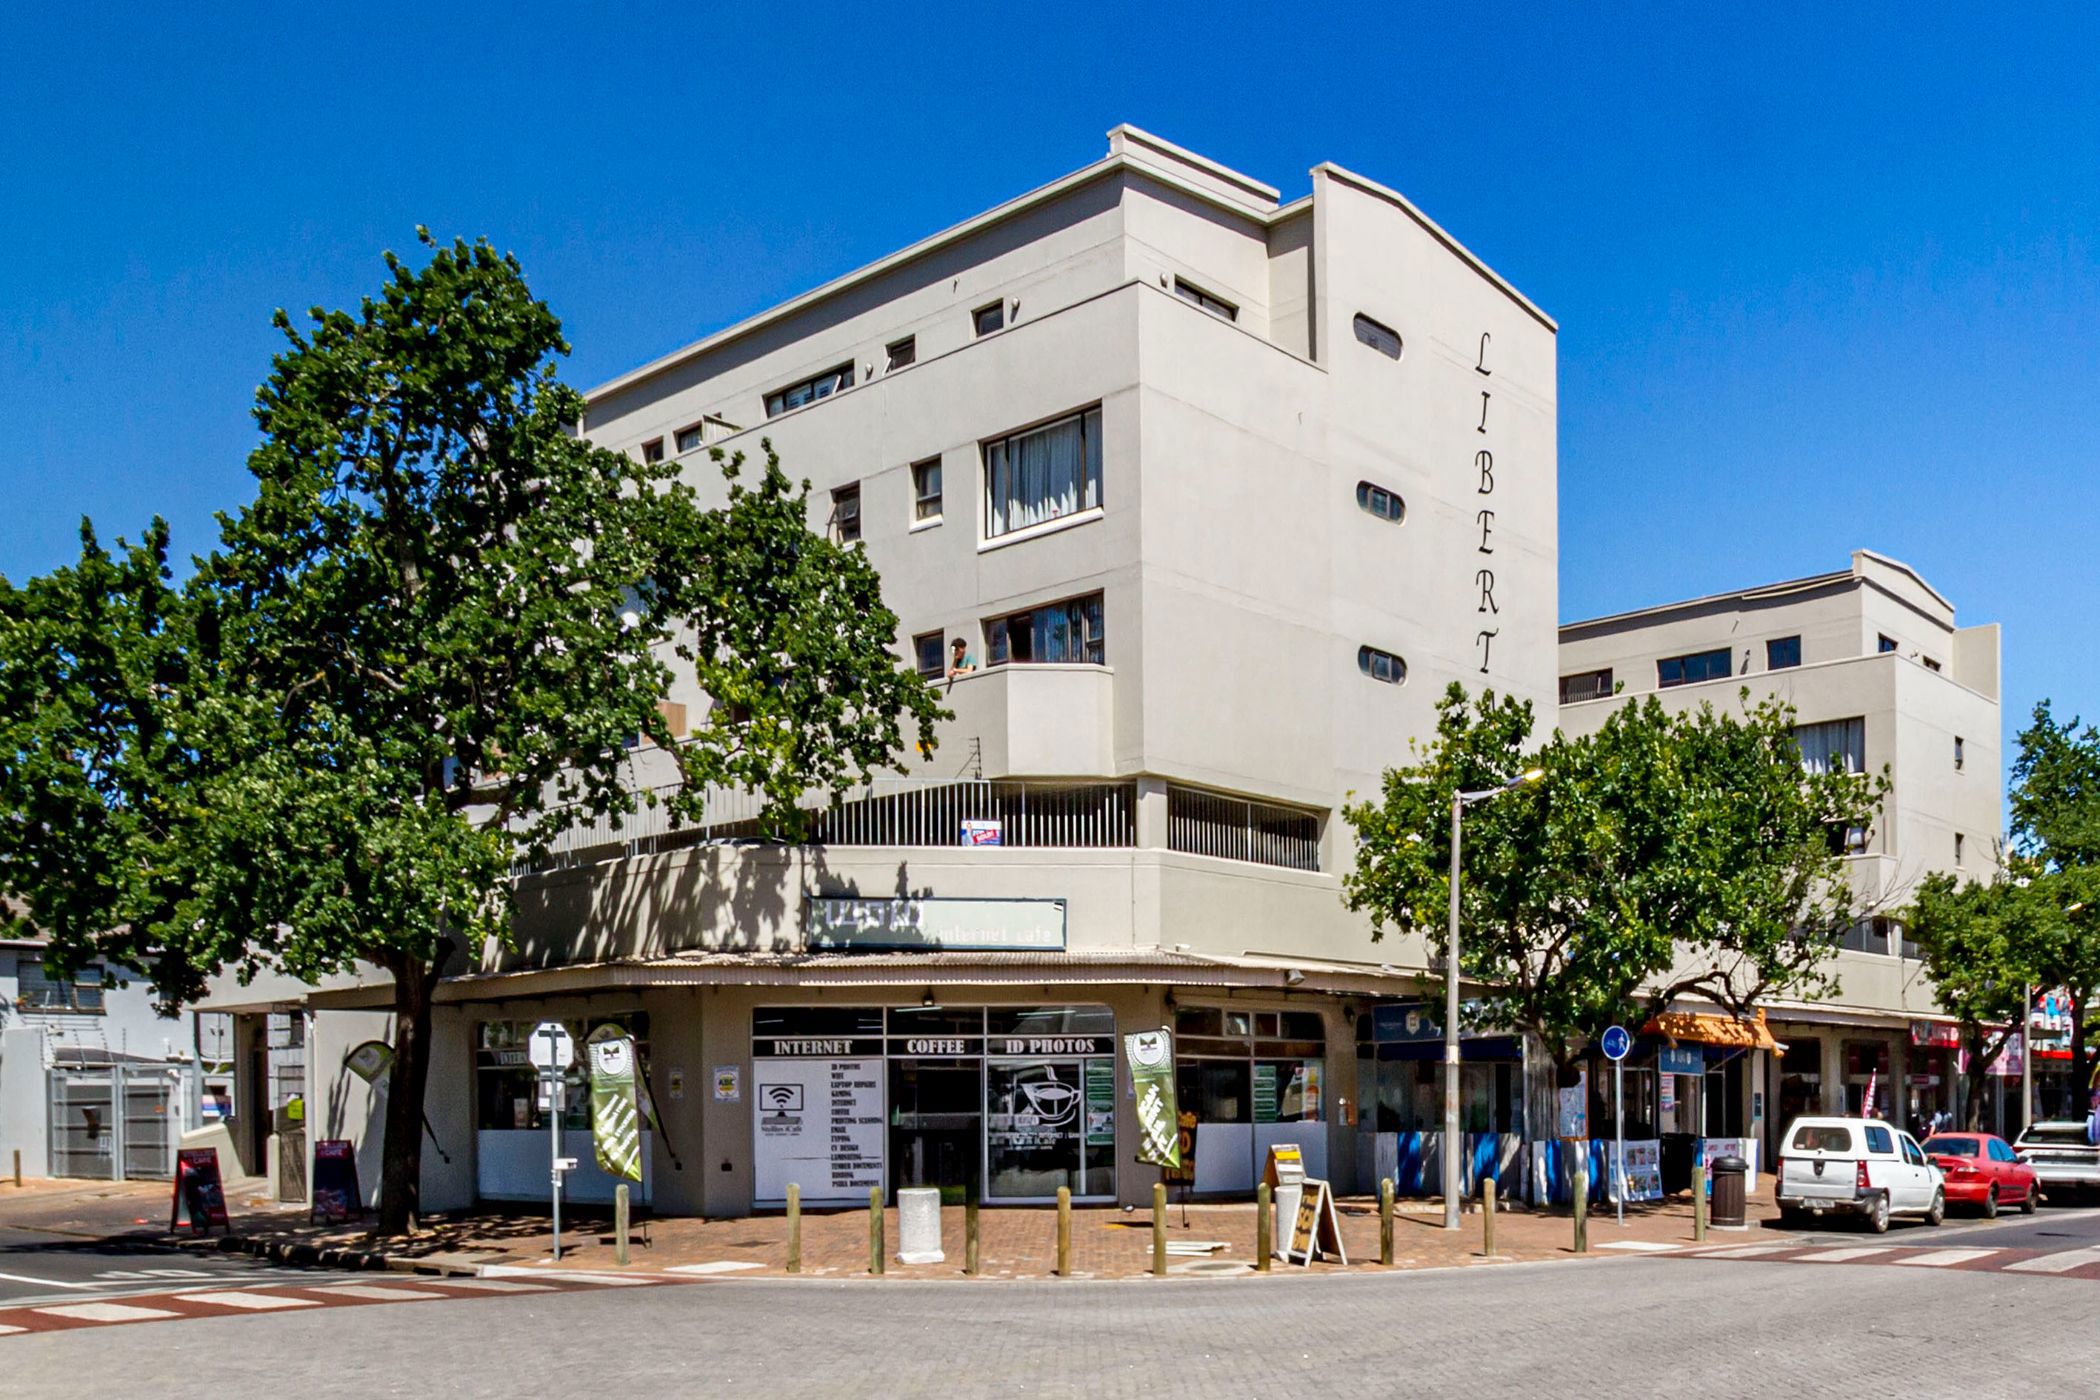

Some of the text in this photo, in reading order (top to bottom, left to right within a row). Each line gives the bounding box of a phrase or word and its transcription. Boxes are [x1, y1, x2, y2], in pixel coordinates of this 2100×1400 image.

[1475, 332, 1500, 712] LIBERT
[774, 1040, 853, 1055] INTERNET
[907, 1039, 965, 1054] COFFEE
[1006, 1038, 1095, 1054] ID PHOTOS
